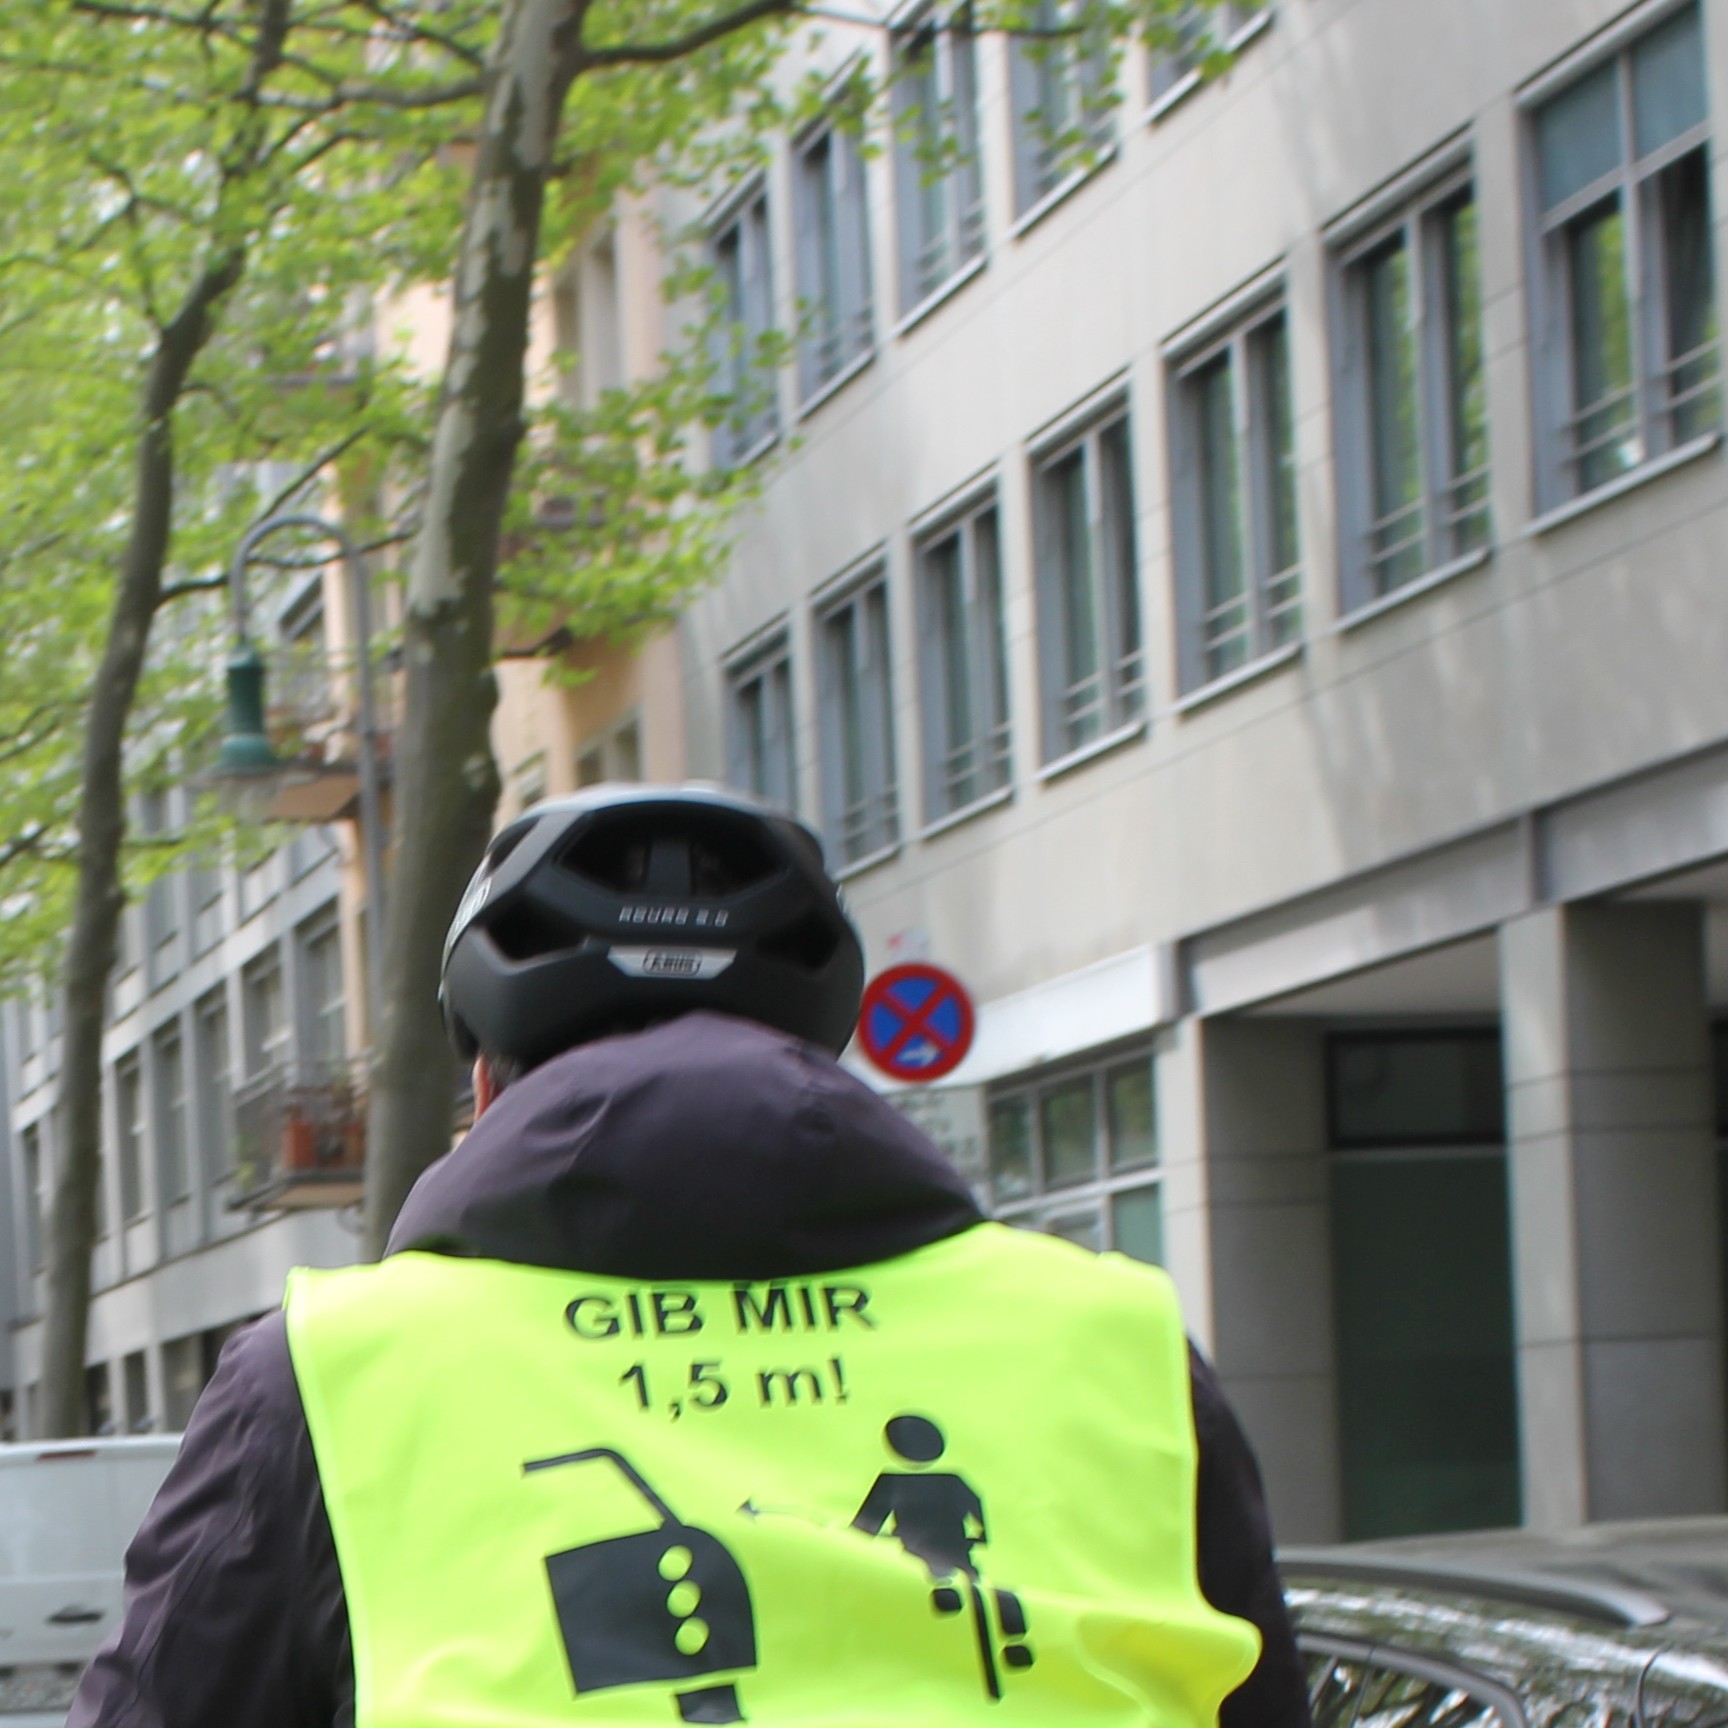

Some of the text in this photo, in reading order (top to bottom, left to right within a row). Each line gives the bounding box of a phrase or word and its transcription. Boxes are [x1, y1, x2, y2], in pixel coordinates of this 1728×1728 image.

[564, 1281, 877, 1340] GIB MIR
[618, 1353, 850, 1422] 1,5 m!
